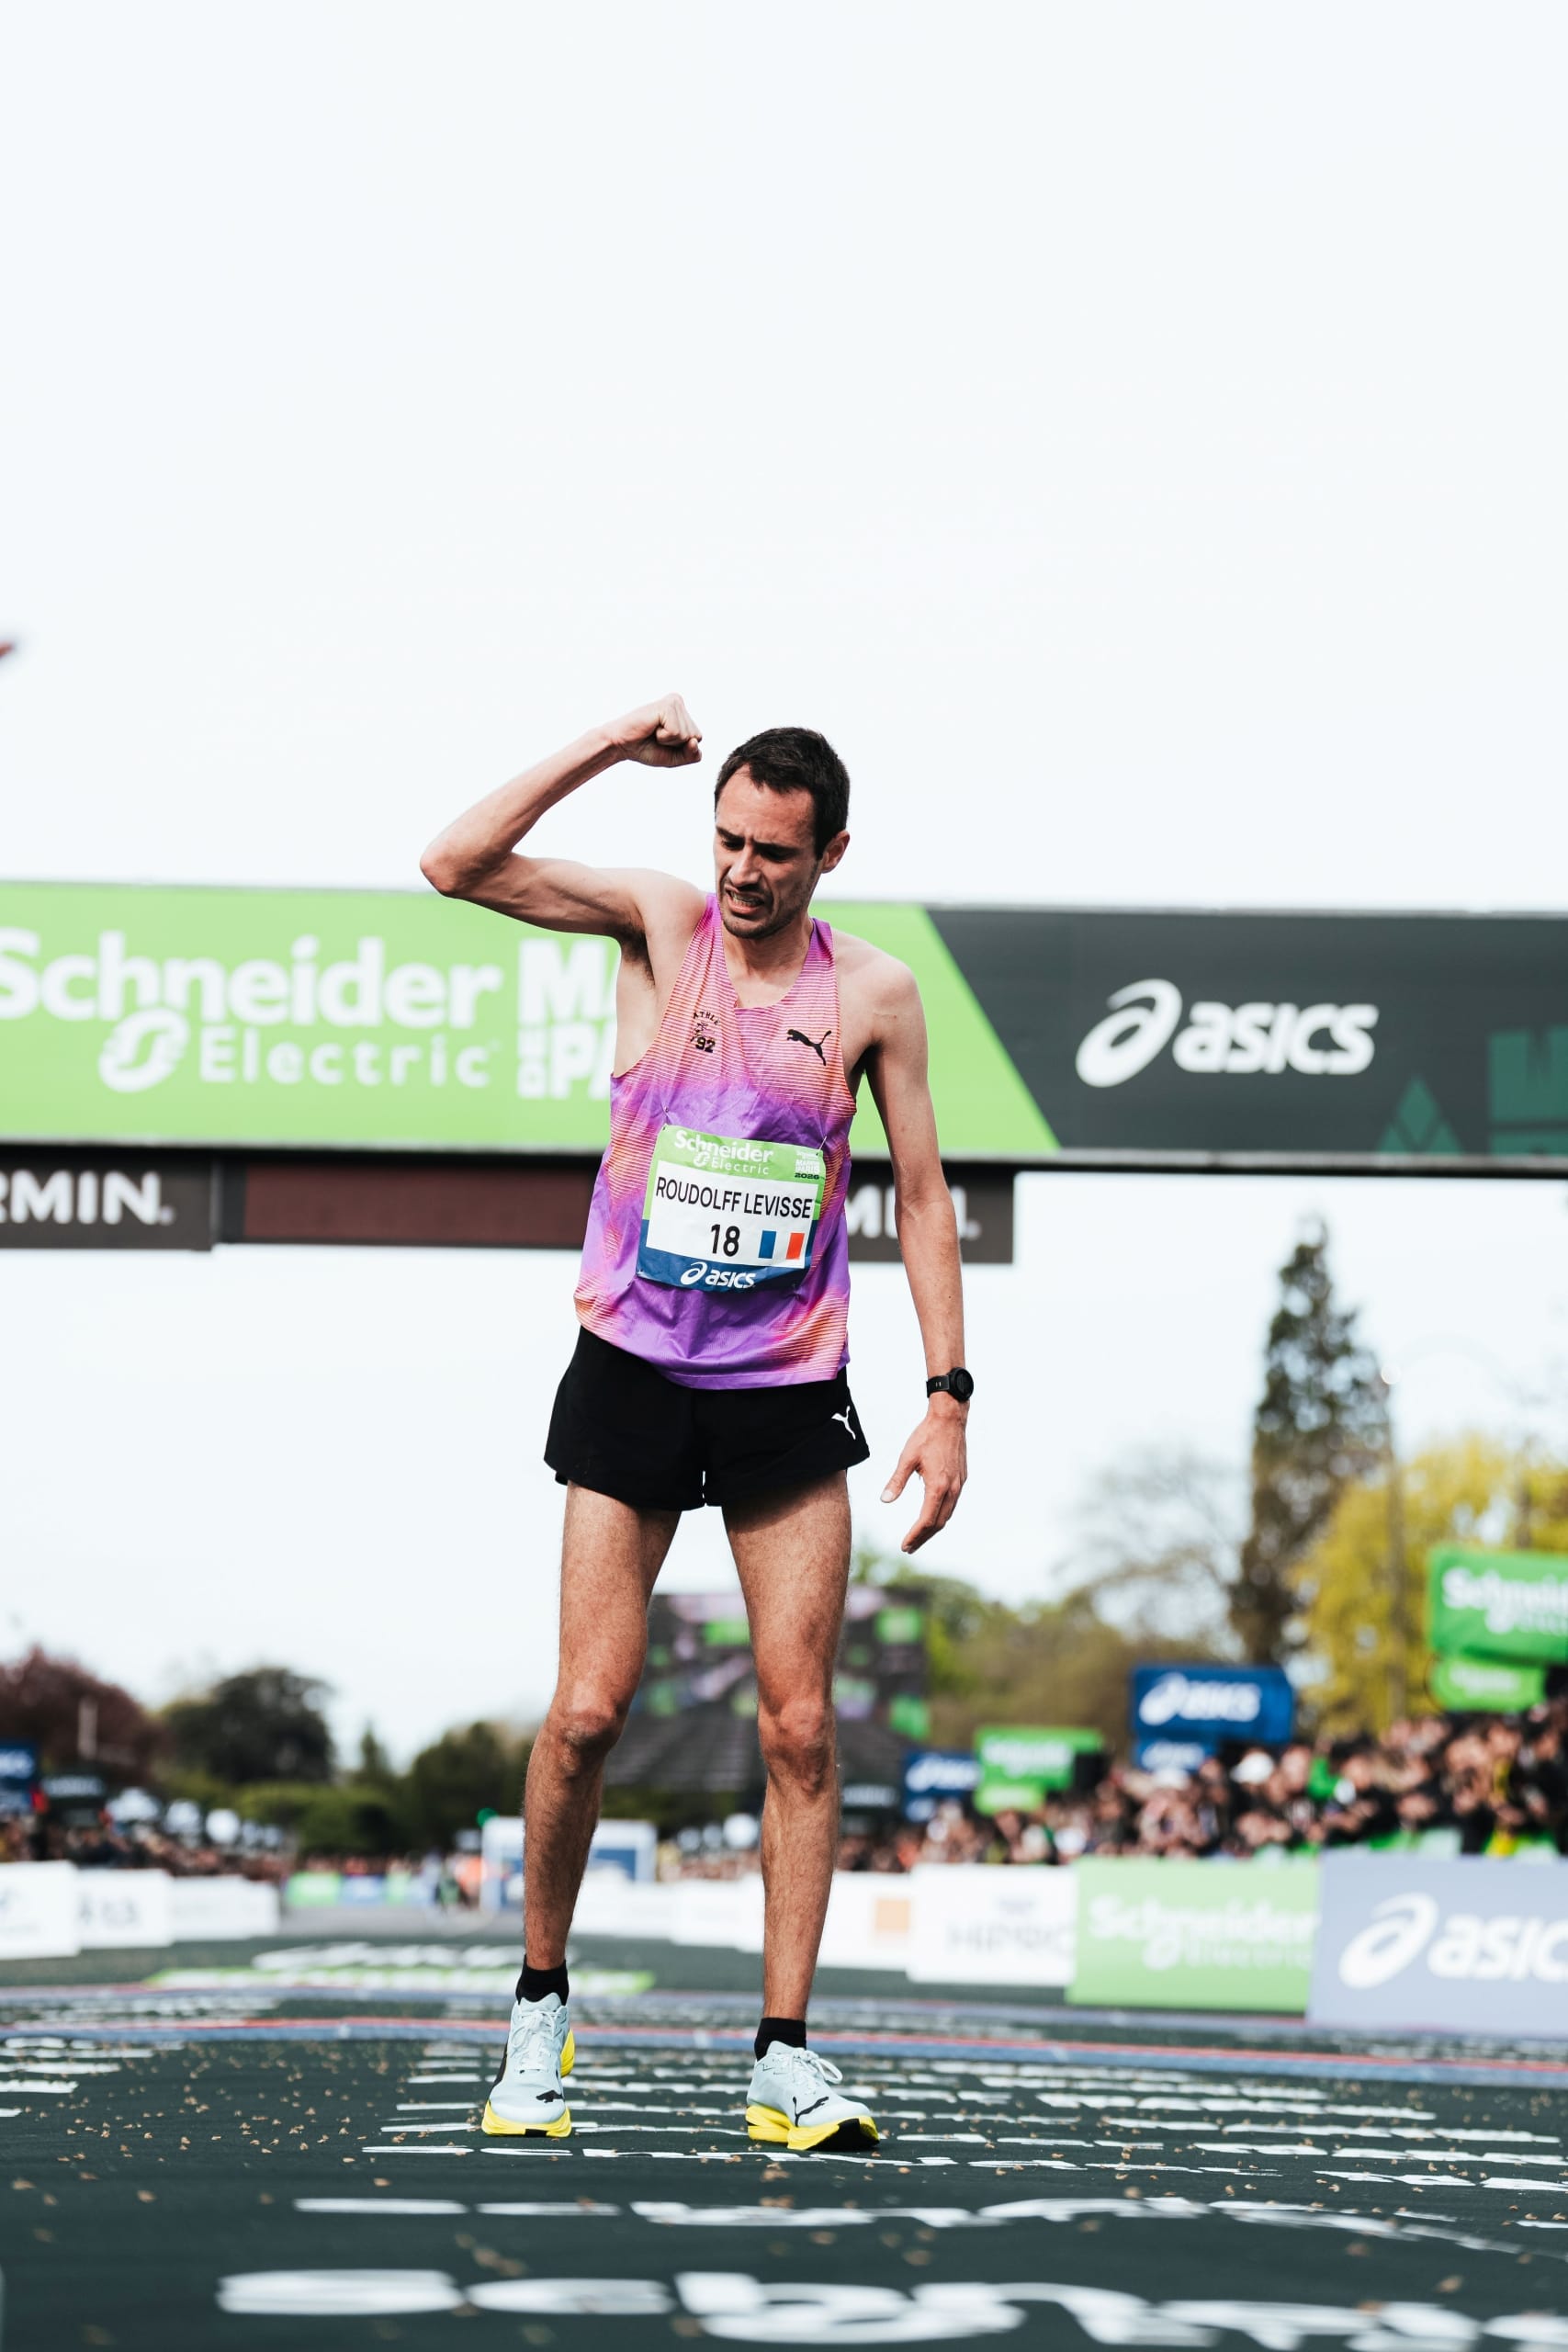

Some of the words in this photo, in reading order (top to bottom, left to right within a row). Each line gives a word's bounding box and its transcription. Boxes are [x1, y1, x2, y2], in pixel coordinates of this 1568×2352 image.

[0, 928, 502, 1028] Schneider
[695, 1036, 716, 1053] 92
[1172, 1001, 1379, 1076] asics
[198, 1025, 491, 1087] Electric
[674, 1130, 773, 1164] Schneider
[711, 1157, 770, 1175] Electric
[656, 1177, 742, 1213] ROUDOLFF
[743, 1193, 813, 1219] LEVISSE
[710, 1224, 740, 1257] 18
[705, 1272, 757, 1289] asics
